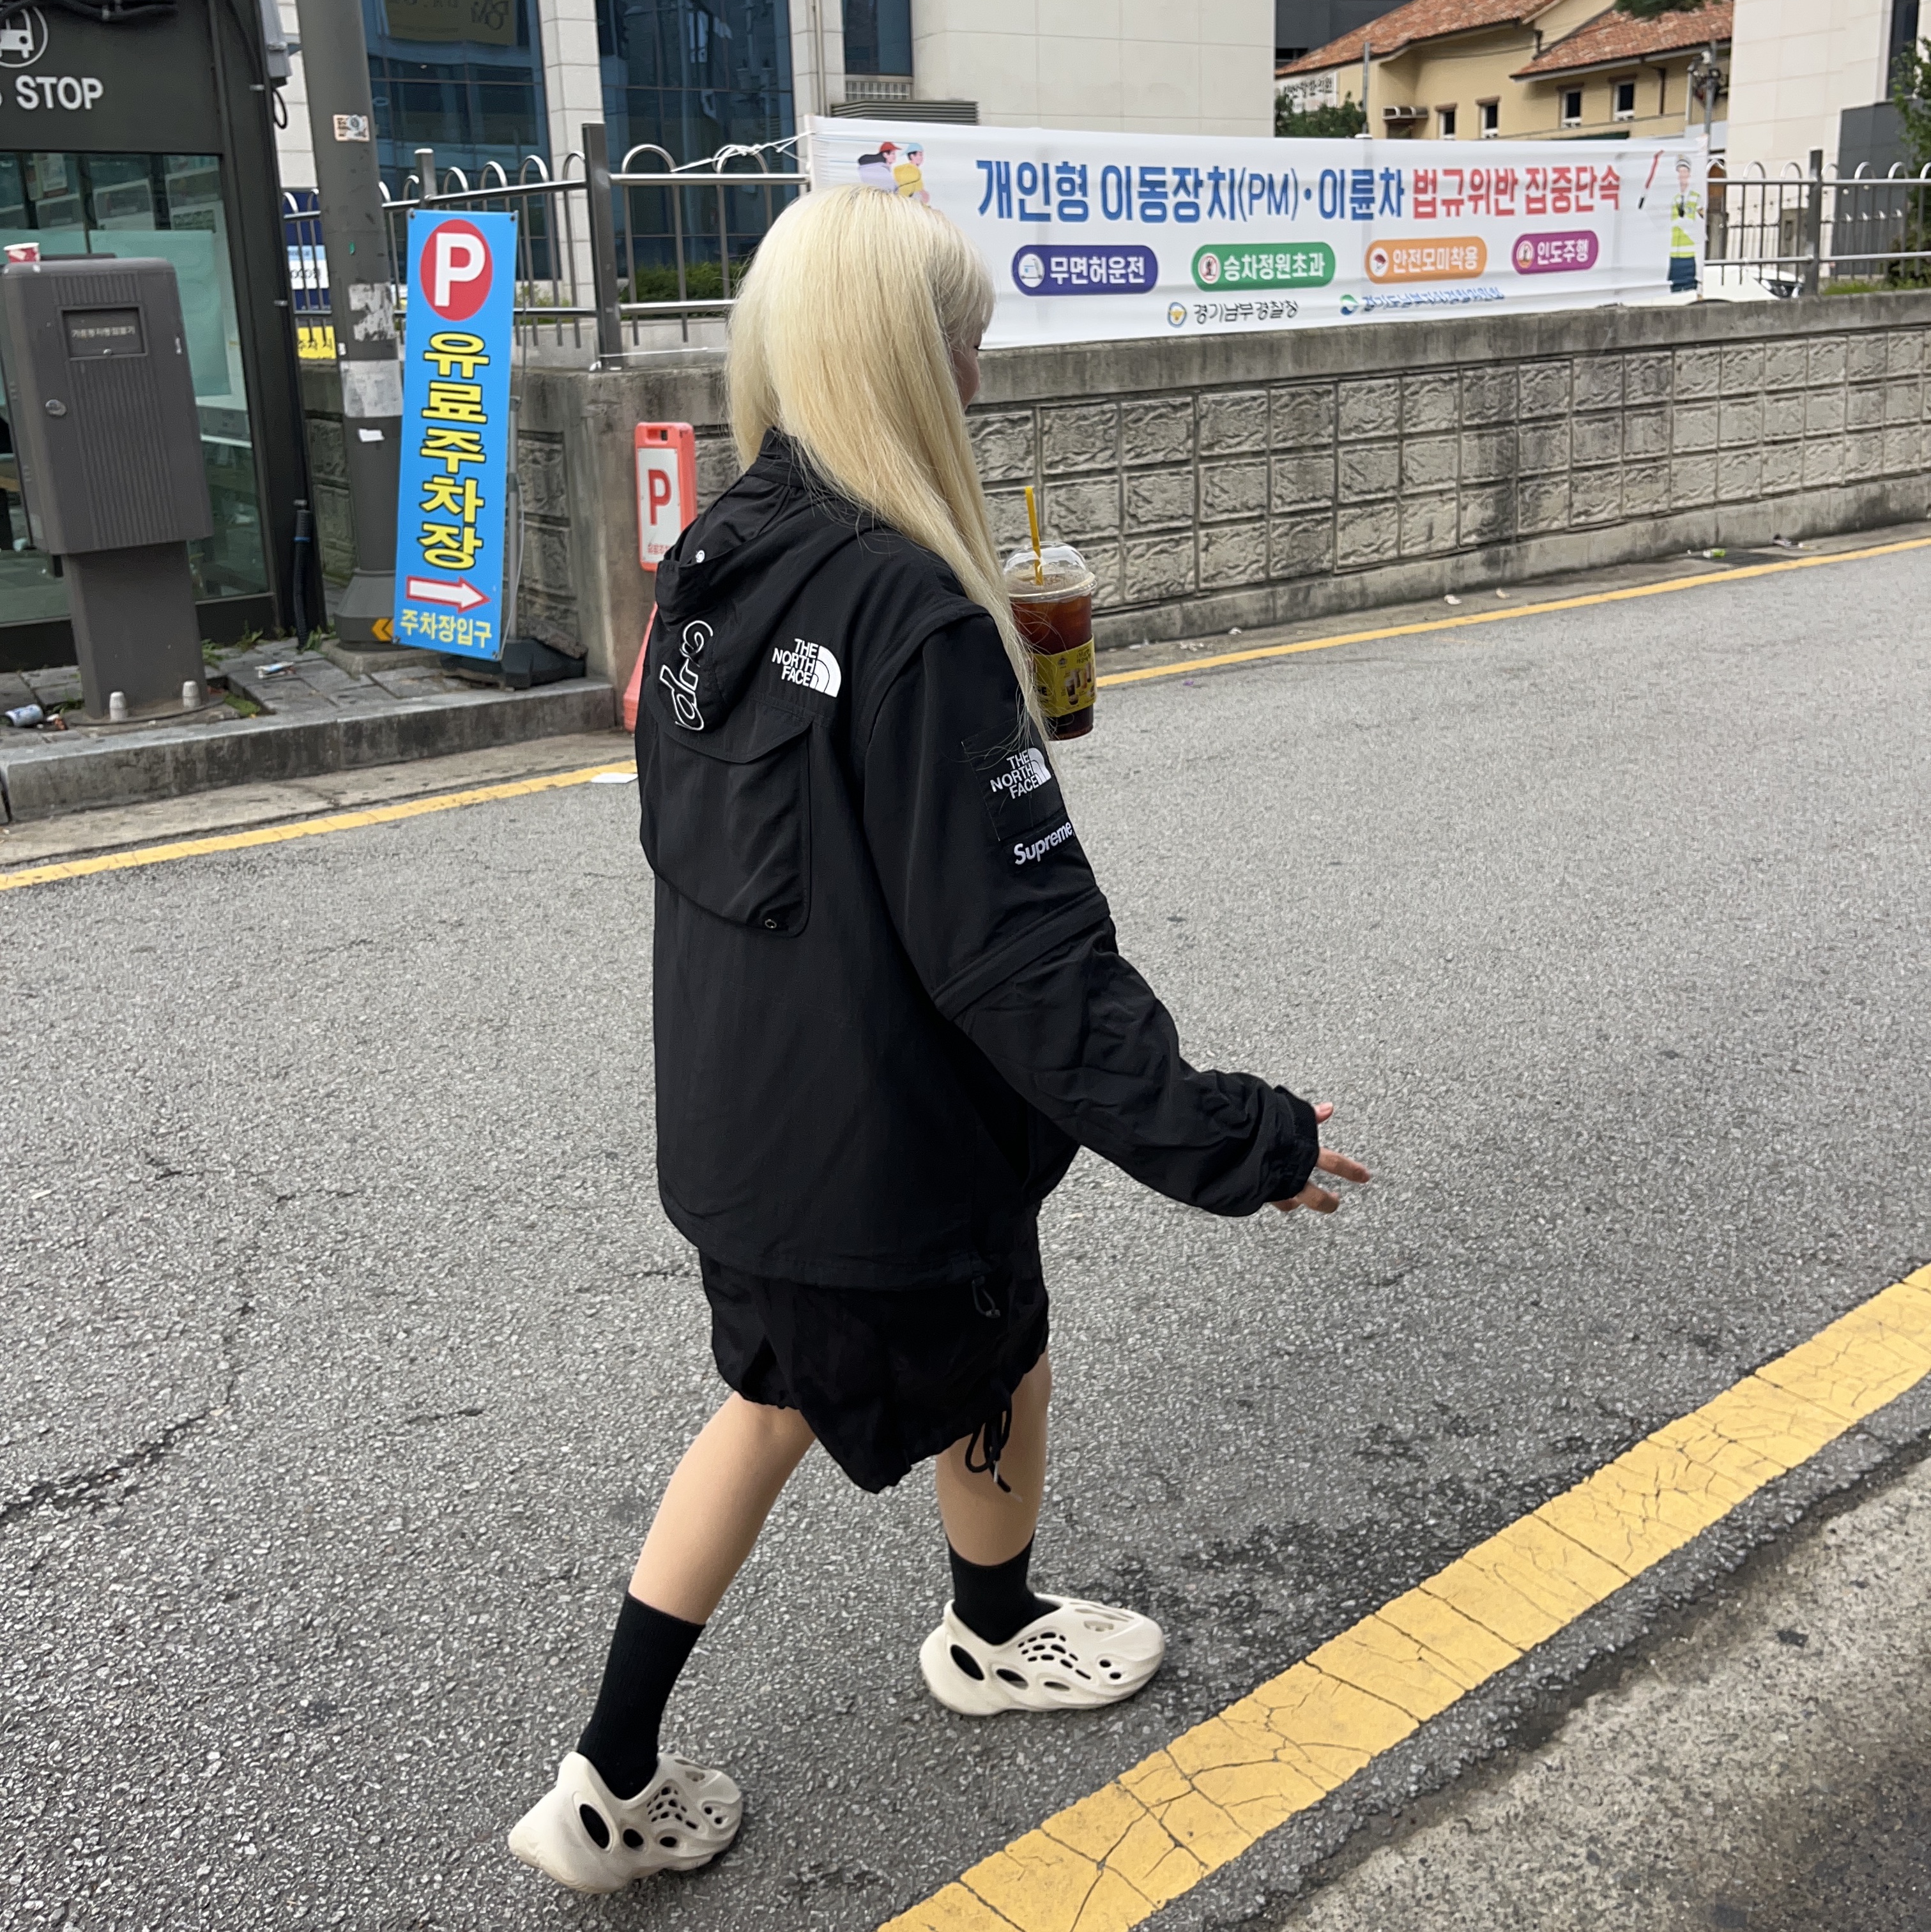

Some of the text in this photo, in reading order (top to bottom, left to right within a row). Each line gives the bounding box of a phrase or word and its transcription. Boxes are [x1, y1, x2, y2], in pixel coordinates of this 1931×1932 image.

[15, 75, 104, 110] STOP
[976, 160, 1088, 222] 개인형
[1412, 167, 1518, 219] 법규위반
[1524, 164, 1621, 215] 집중단속
[1393, 245, 1479, 273] 안전모미착용
[1538, 238, 1589, 266] 인도주행
[434, 232, 485, 307] P
[1049, 256, 1145, 285] 무면허운전
[1223, 252, 1325, 282] 승차정원초과
[1193, 300, 1299, 324] 경기남부경찰청
[417, 331, 490, 570] 유료주차장
[648, 468, 672, 526] P
[400, 609, 492, 649] 주차장입구
[772, 648, 816, 674] NORTH
[795, 638, 818, 658] THE
[781, 665, 812, 687] FACE
[1007, 750, 1030, 770] THE
[990, 764, 1034, 793] NORTH
[1009, 775, 1039, 799] FACE
[1014, 822, 1072, 865] Supreme
